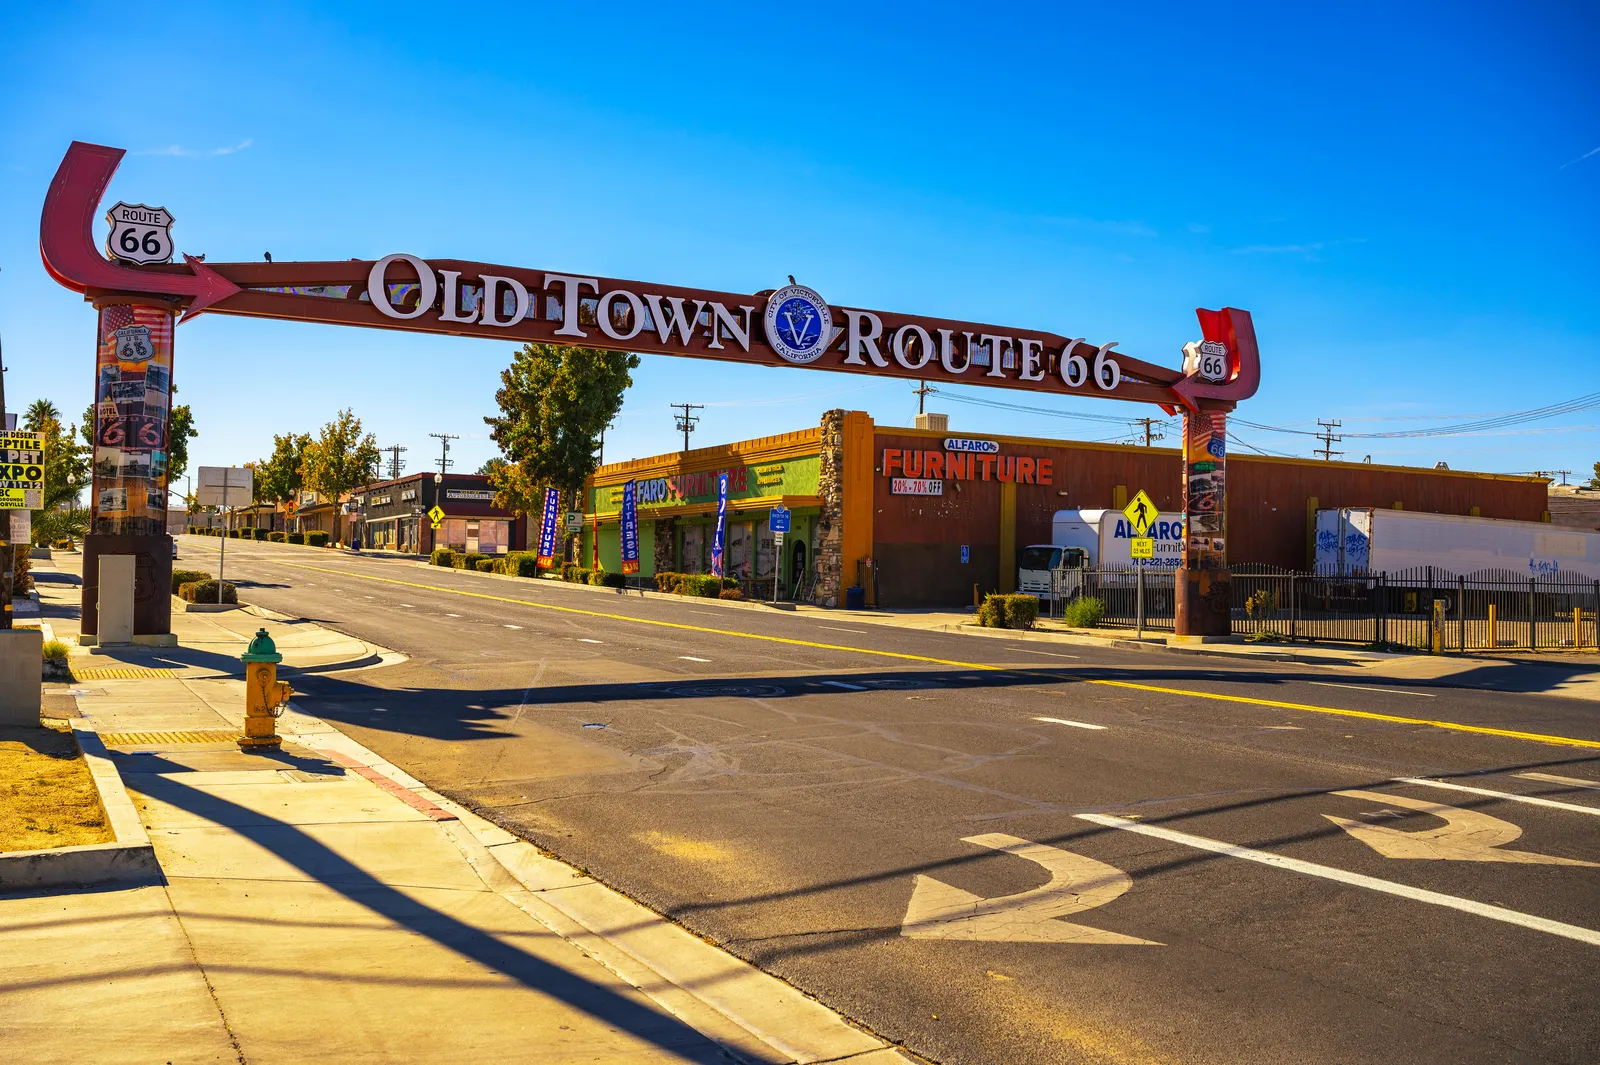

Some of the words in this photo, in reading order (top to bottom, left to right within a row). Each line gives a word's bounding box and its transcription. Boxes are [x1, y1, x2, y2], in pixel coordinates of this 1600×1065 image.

[122, 208, 162, 225] ROUTE
[119, 227, 162, 256] 66
[768, 299, 778, 319] CITY
[779, 290, 788, 299] OF
[790, 288, 830, 325] VICTORVILLE
[367, 252, 530, 328] OLD
[542, 272, 756, 354] TOWN
[841, 308, 1045, 382] ROUTE
[1059, 336, 1121, 391] 66
[122, 341, 148, 358] 66
[775, 342, 822, 361] CALIFORNIA
[1204, 344, 1223, 354] ROUTE
[1203, 356, 1223, 376] 66
[10, 431, 38, 440] DESERT
[0, 439, 41, 450] EPTILE
[947, 439, 990, 452] ALFARO
[7, 450, 41, 464] PET
[0, 465, 42, 481] XPO
[882, 448, 1053, 486] FURNITURE
[12, 481, 42, 489] 11-12
[667, 466, 748, 500] FURNITRE
[928, 481, 942, 495] OFF
[541, 490, 556, 556] FURNITURE
[1113, 519, 1183, 541] ALARO
